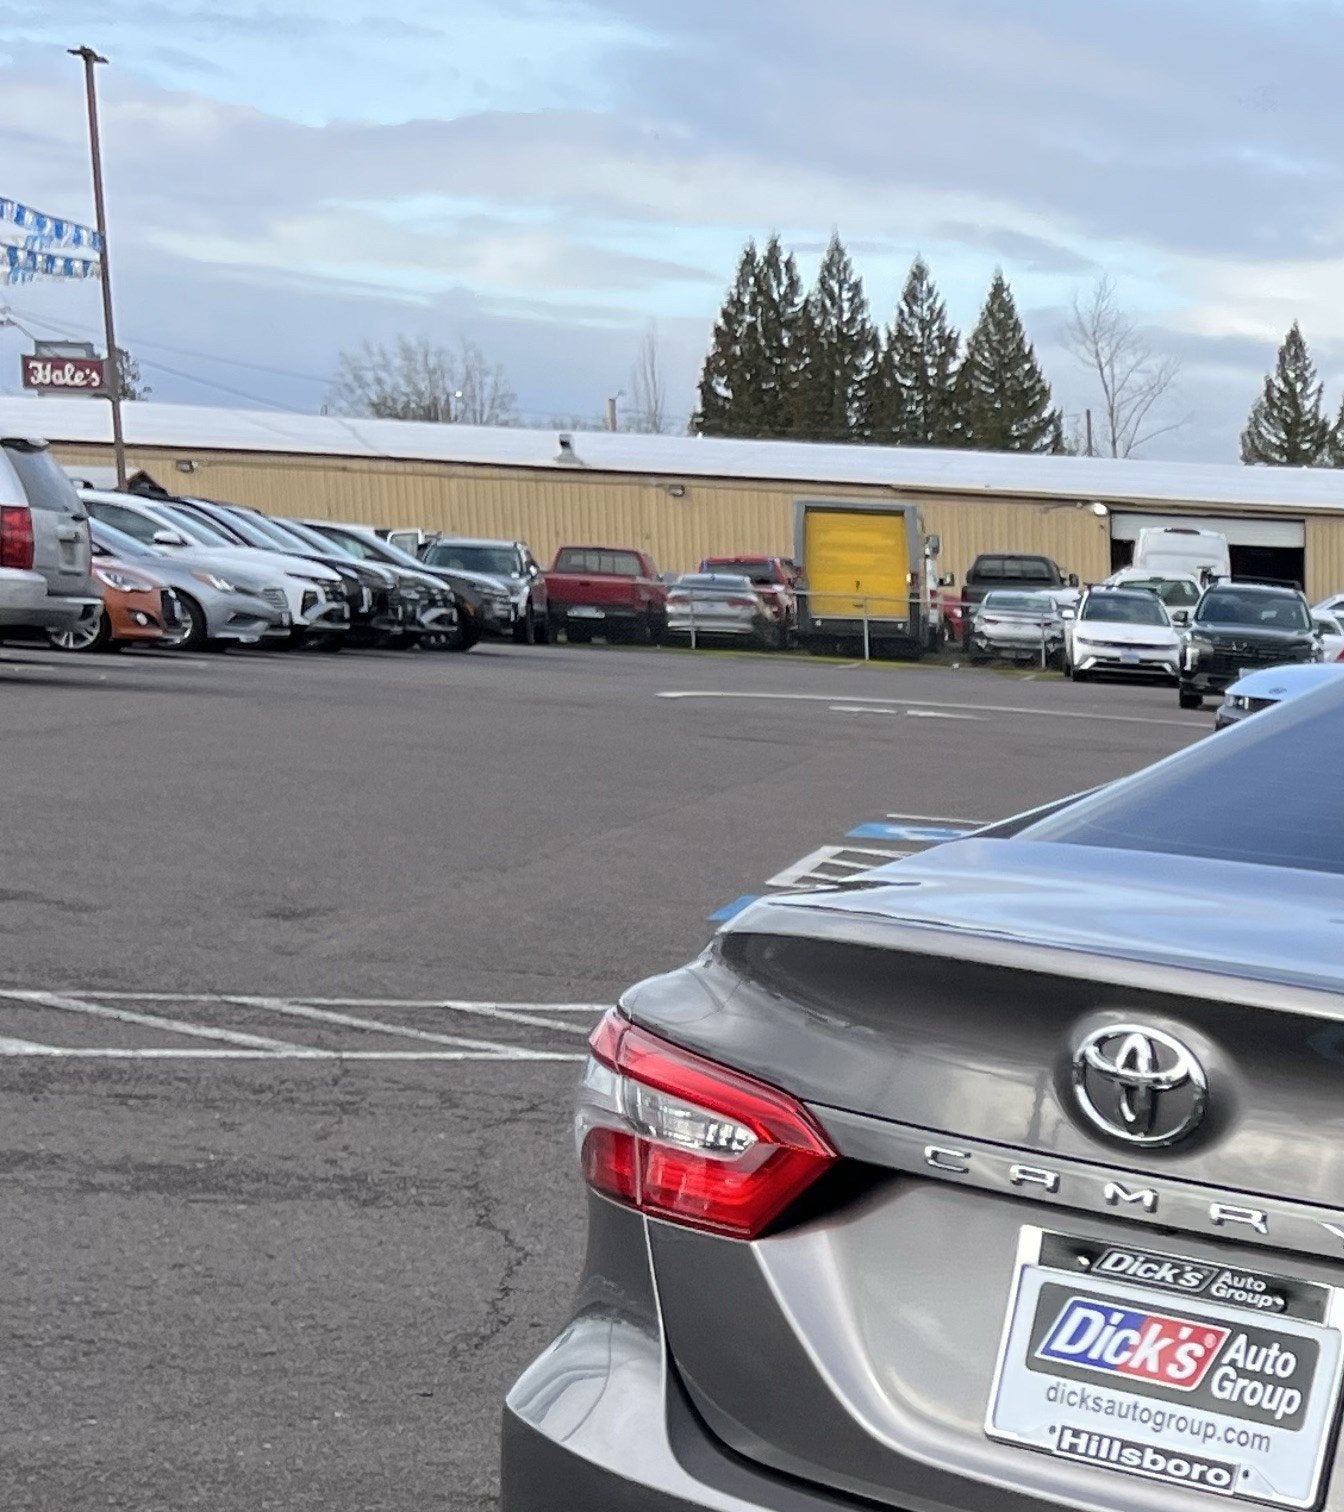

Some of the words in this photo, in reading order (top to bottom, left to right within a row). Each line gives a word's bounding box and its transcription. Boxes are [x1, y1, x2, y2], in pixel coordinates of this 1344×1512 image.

[28, 360, 101, 387] Hale's
[1102, 1252, 1205, 1288] Dick's
[1218, 1271, 1267, 1293] Auto
[1210, 1283, 1273, 1309] Group
[1050, 1307, 1206, 1380] Dick's
[1222, 1333, 1297, 1379] Auto
[1210, 1366, 1303, 1420] Group
[1046, 1381, 1272, 1453] dicksautogroup.com
[1059, 1428, 1232, 1487] Hillsboro
